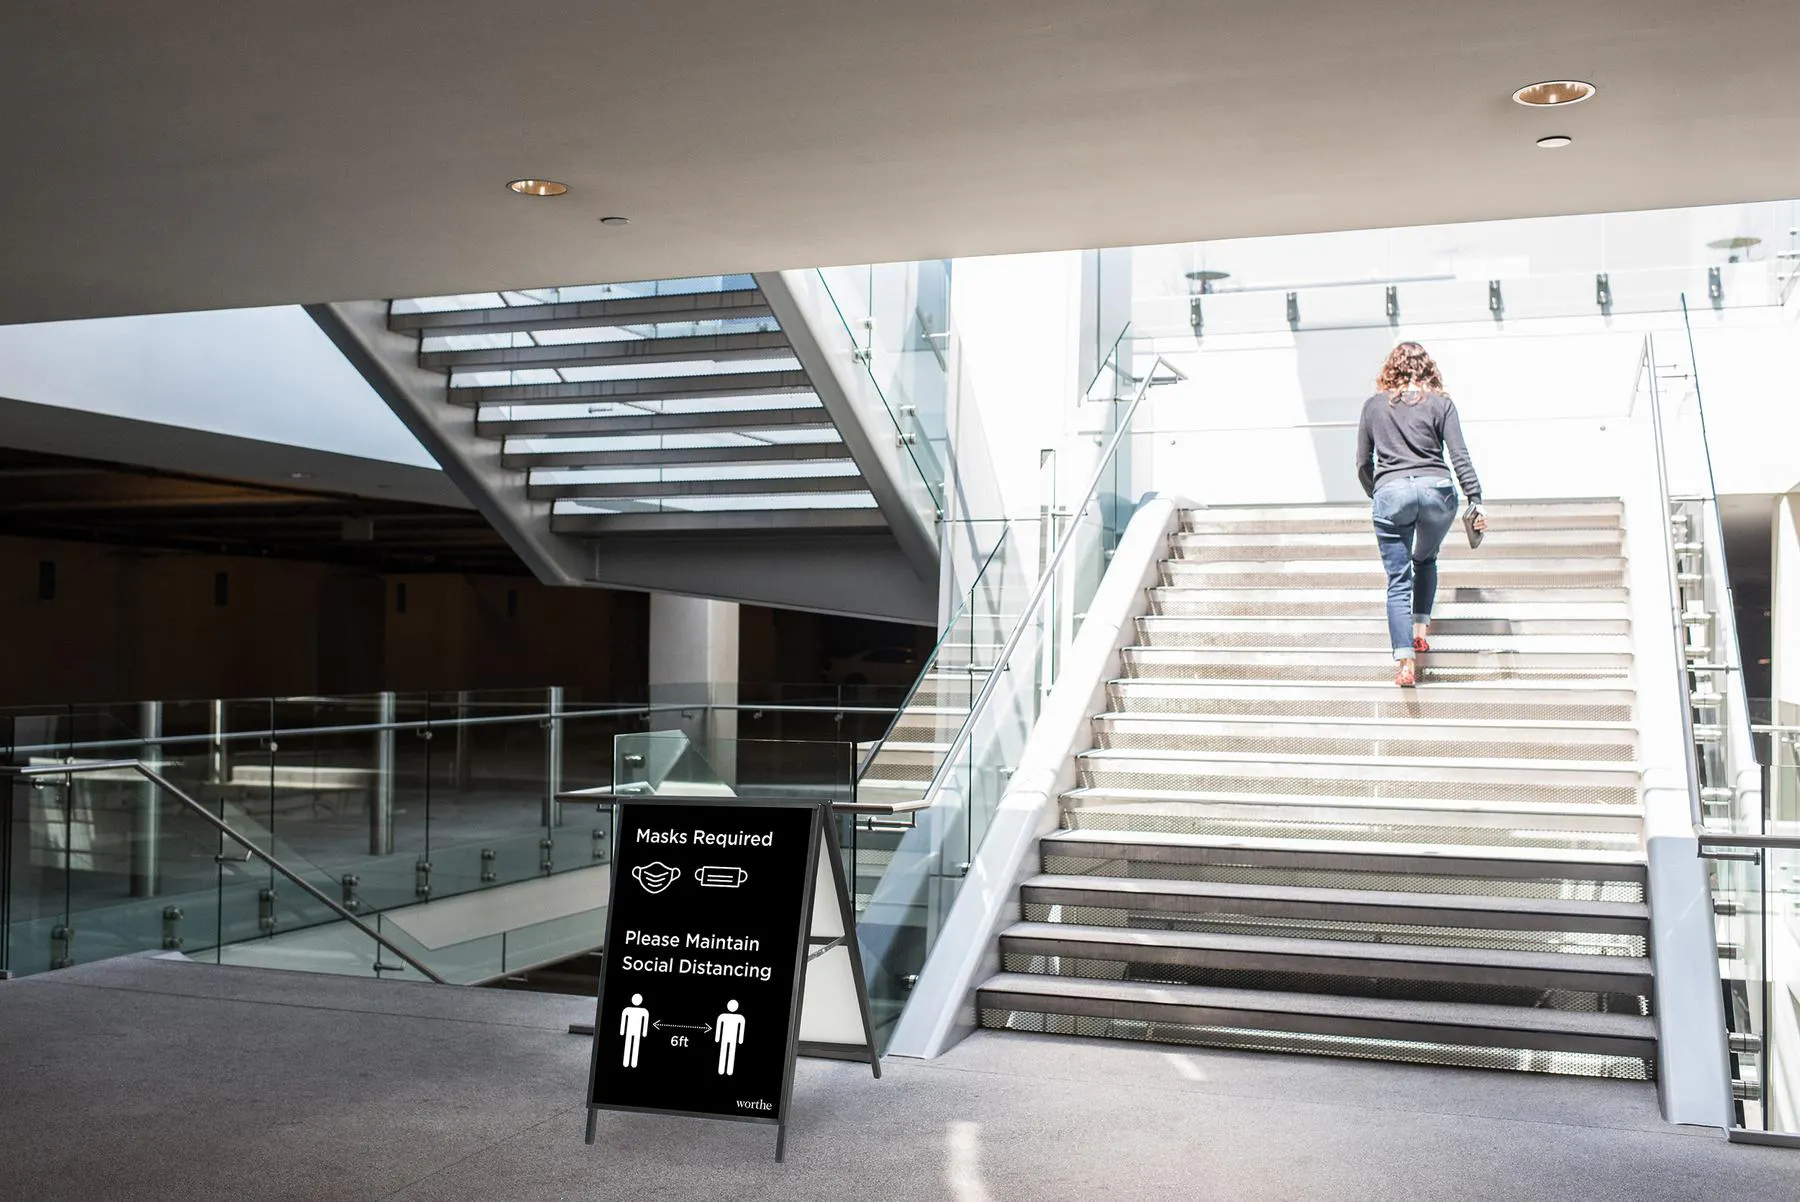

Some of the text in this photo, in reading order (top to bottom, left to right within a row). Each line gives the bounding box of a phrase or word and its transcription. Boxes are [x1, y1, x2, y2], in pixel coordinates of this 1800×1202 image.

[636, 828, 774, 848] Masks Required
[625, 930, 760, 952] Please Maintain
[622, 955, 772, 981] Social Distancing
[670, 1035, 689, 1047] 6ft
[736, 1098, 773, 1111] worthe
